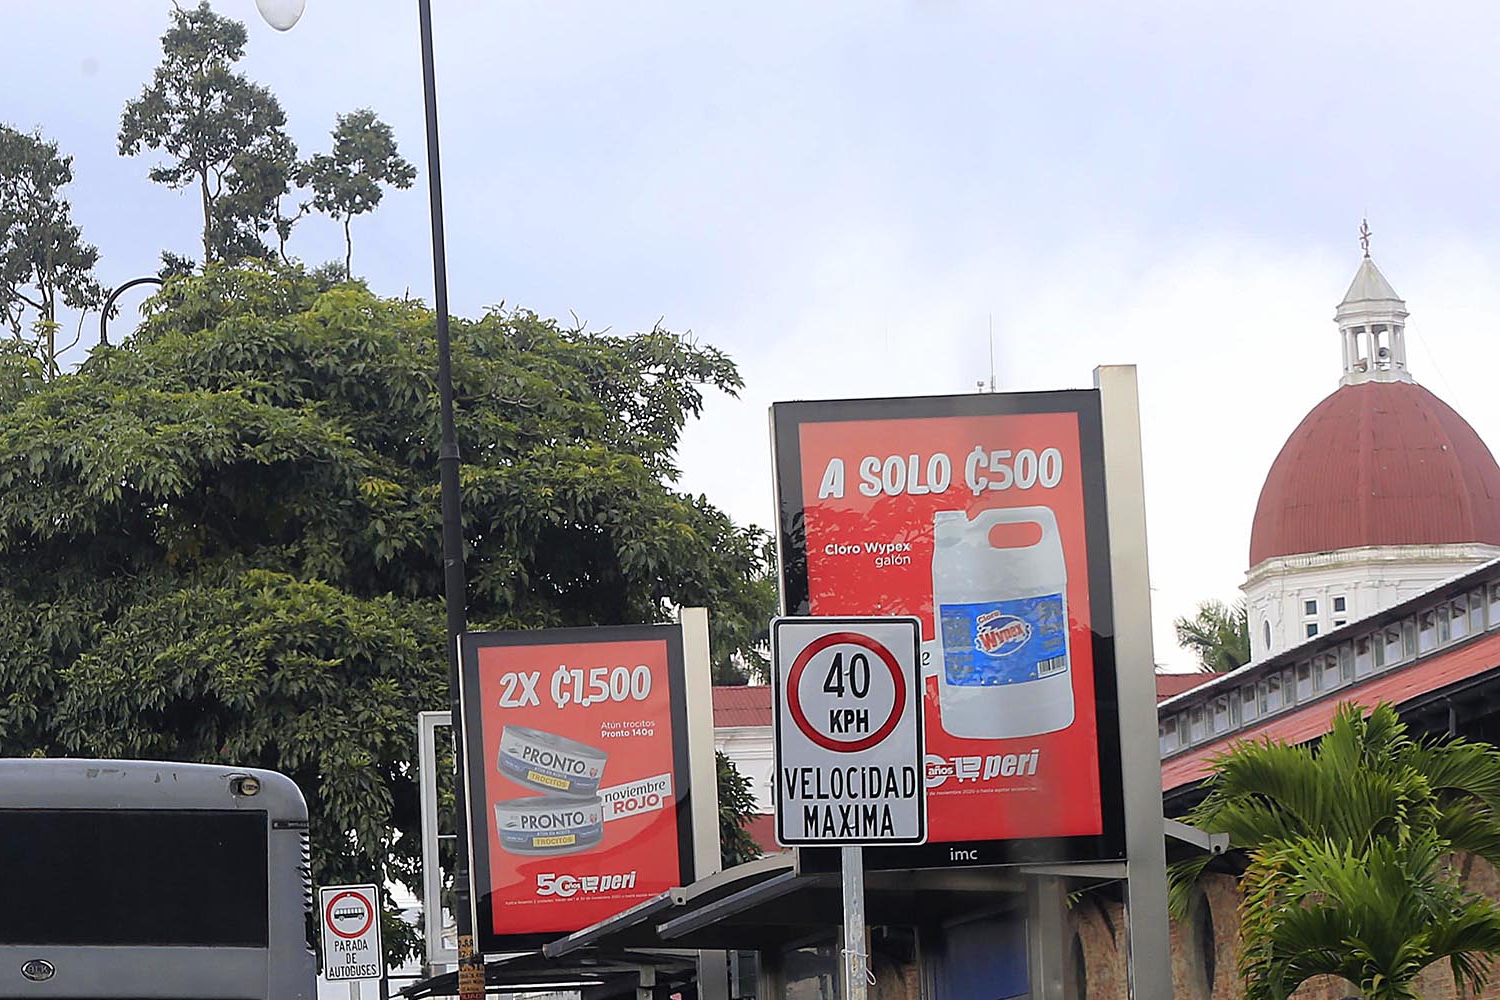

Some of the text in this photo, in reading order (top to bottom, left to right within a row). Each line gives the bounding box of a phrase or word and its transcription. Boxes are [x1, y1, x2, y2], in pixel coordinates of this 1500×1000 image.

[818, 458, 845, 499] A
[859, 453, 951, 497] SOLO
[825, 541, 911, 556] Cloro Wypex
[875, 554, 911, 567] galón
[978, 610, 1001, 623] Cloro
[823, 652, 870, 698] 40
[499, 671, 541, 708] 2X
[623, 720, 655, 728] trocitos
[829, 709, 869, 733] KPH
[601, 728, 654, 738] Pronto 140g
[522, 746, 585, 774] PRONTO
[983, 749, 1039, 780] peri
[928, 765, 953, 776] años
[530, 773, 567, 788] TROCITOS
[784, 767, 916, 800] VELOCIDAD
[605, 780, 666, 803] noviembre
[613, 794, 659, 814] ROJO
[521, 812, 584, 829] PRONTO
[804, 804, 894, 837] MAXIMA
[535, 836, 573, 846] TROCITOS
[950, 847, 978, 861] imc
[600, 871, 636, 892] peri
[334, 939, 369, 952] PARADA
[346, 953, 357, 964] DE
[329, 964, 377, 978] AUTOBUSES
